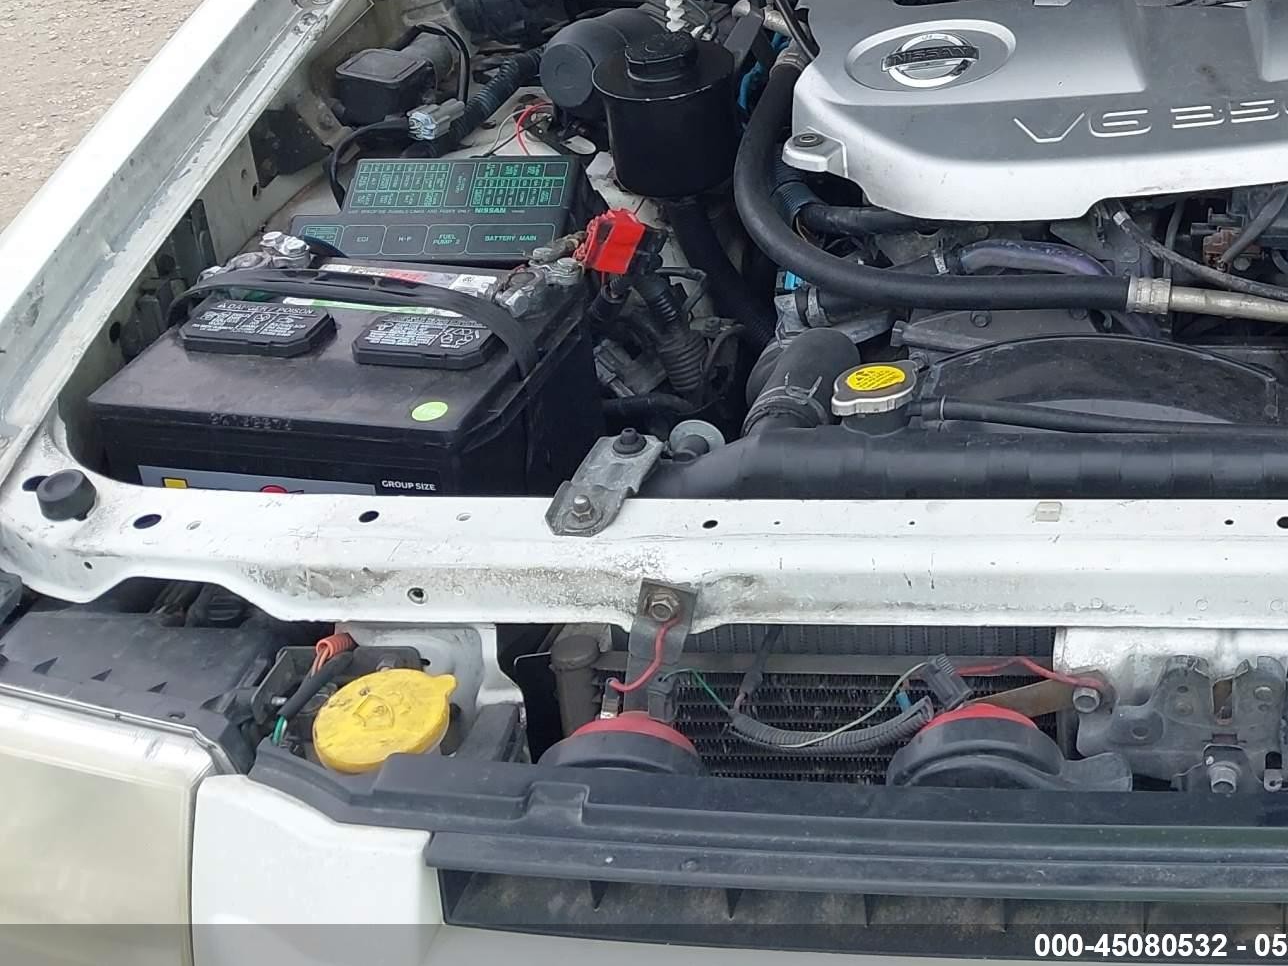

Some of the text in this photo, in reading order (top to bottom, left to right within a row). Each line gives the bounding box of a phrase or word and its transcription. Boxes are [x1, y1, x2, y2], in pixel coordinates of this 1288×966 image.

[890, 45, 970, 67] NISSAN
[1013, 108, 1152, 143] V6
[278, 307, 314, 315] POISON
[381, 480, 436, 491] GROUP SIZE
